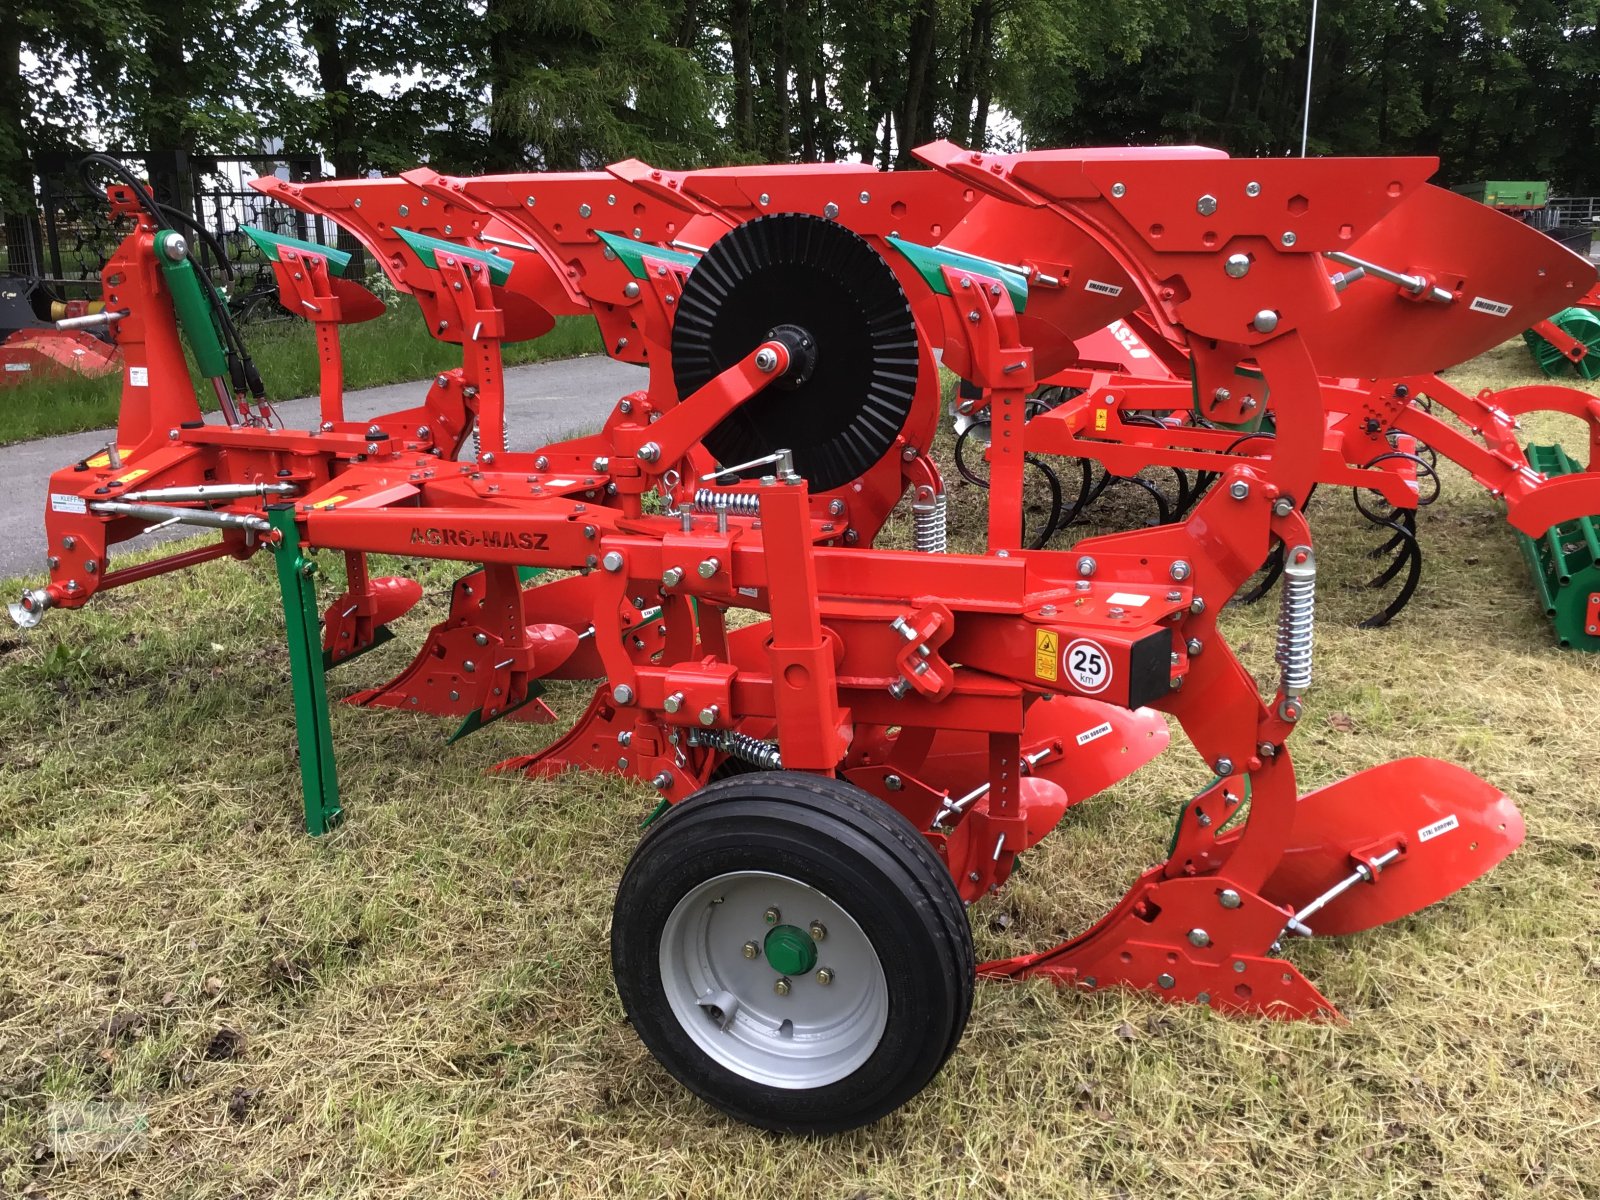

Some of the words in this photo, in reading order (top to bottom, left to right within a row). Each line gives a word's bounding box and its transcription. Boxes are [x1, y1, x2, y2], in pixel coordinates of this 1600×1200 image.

[410, 527, 550, 551] AGRO-MASZ
[1073, 649, 1102, 676] 25
[1080, 673, 1094, 685] km
